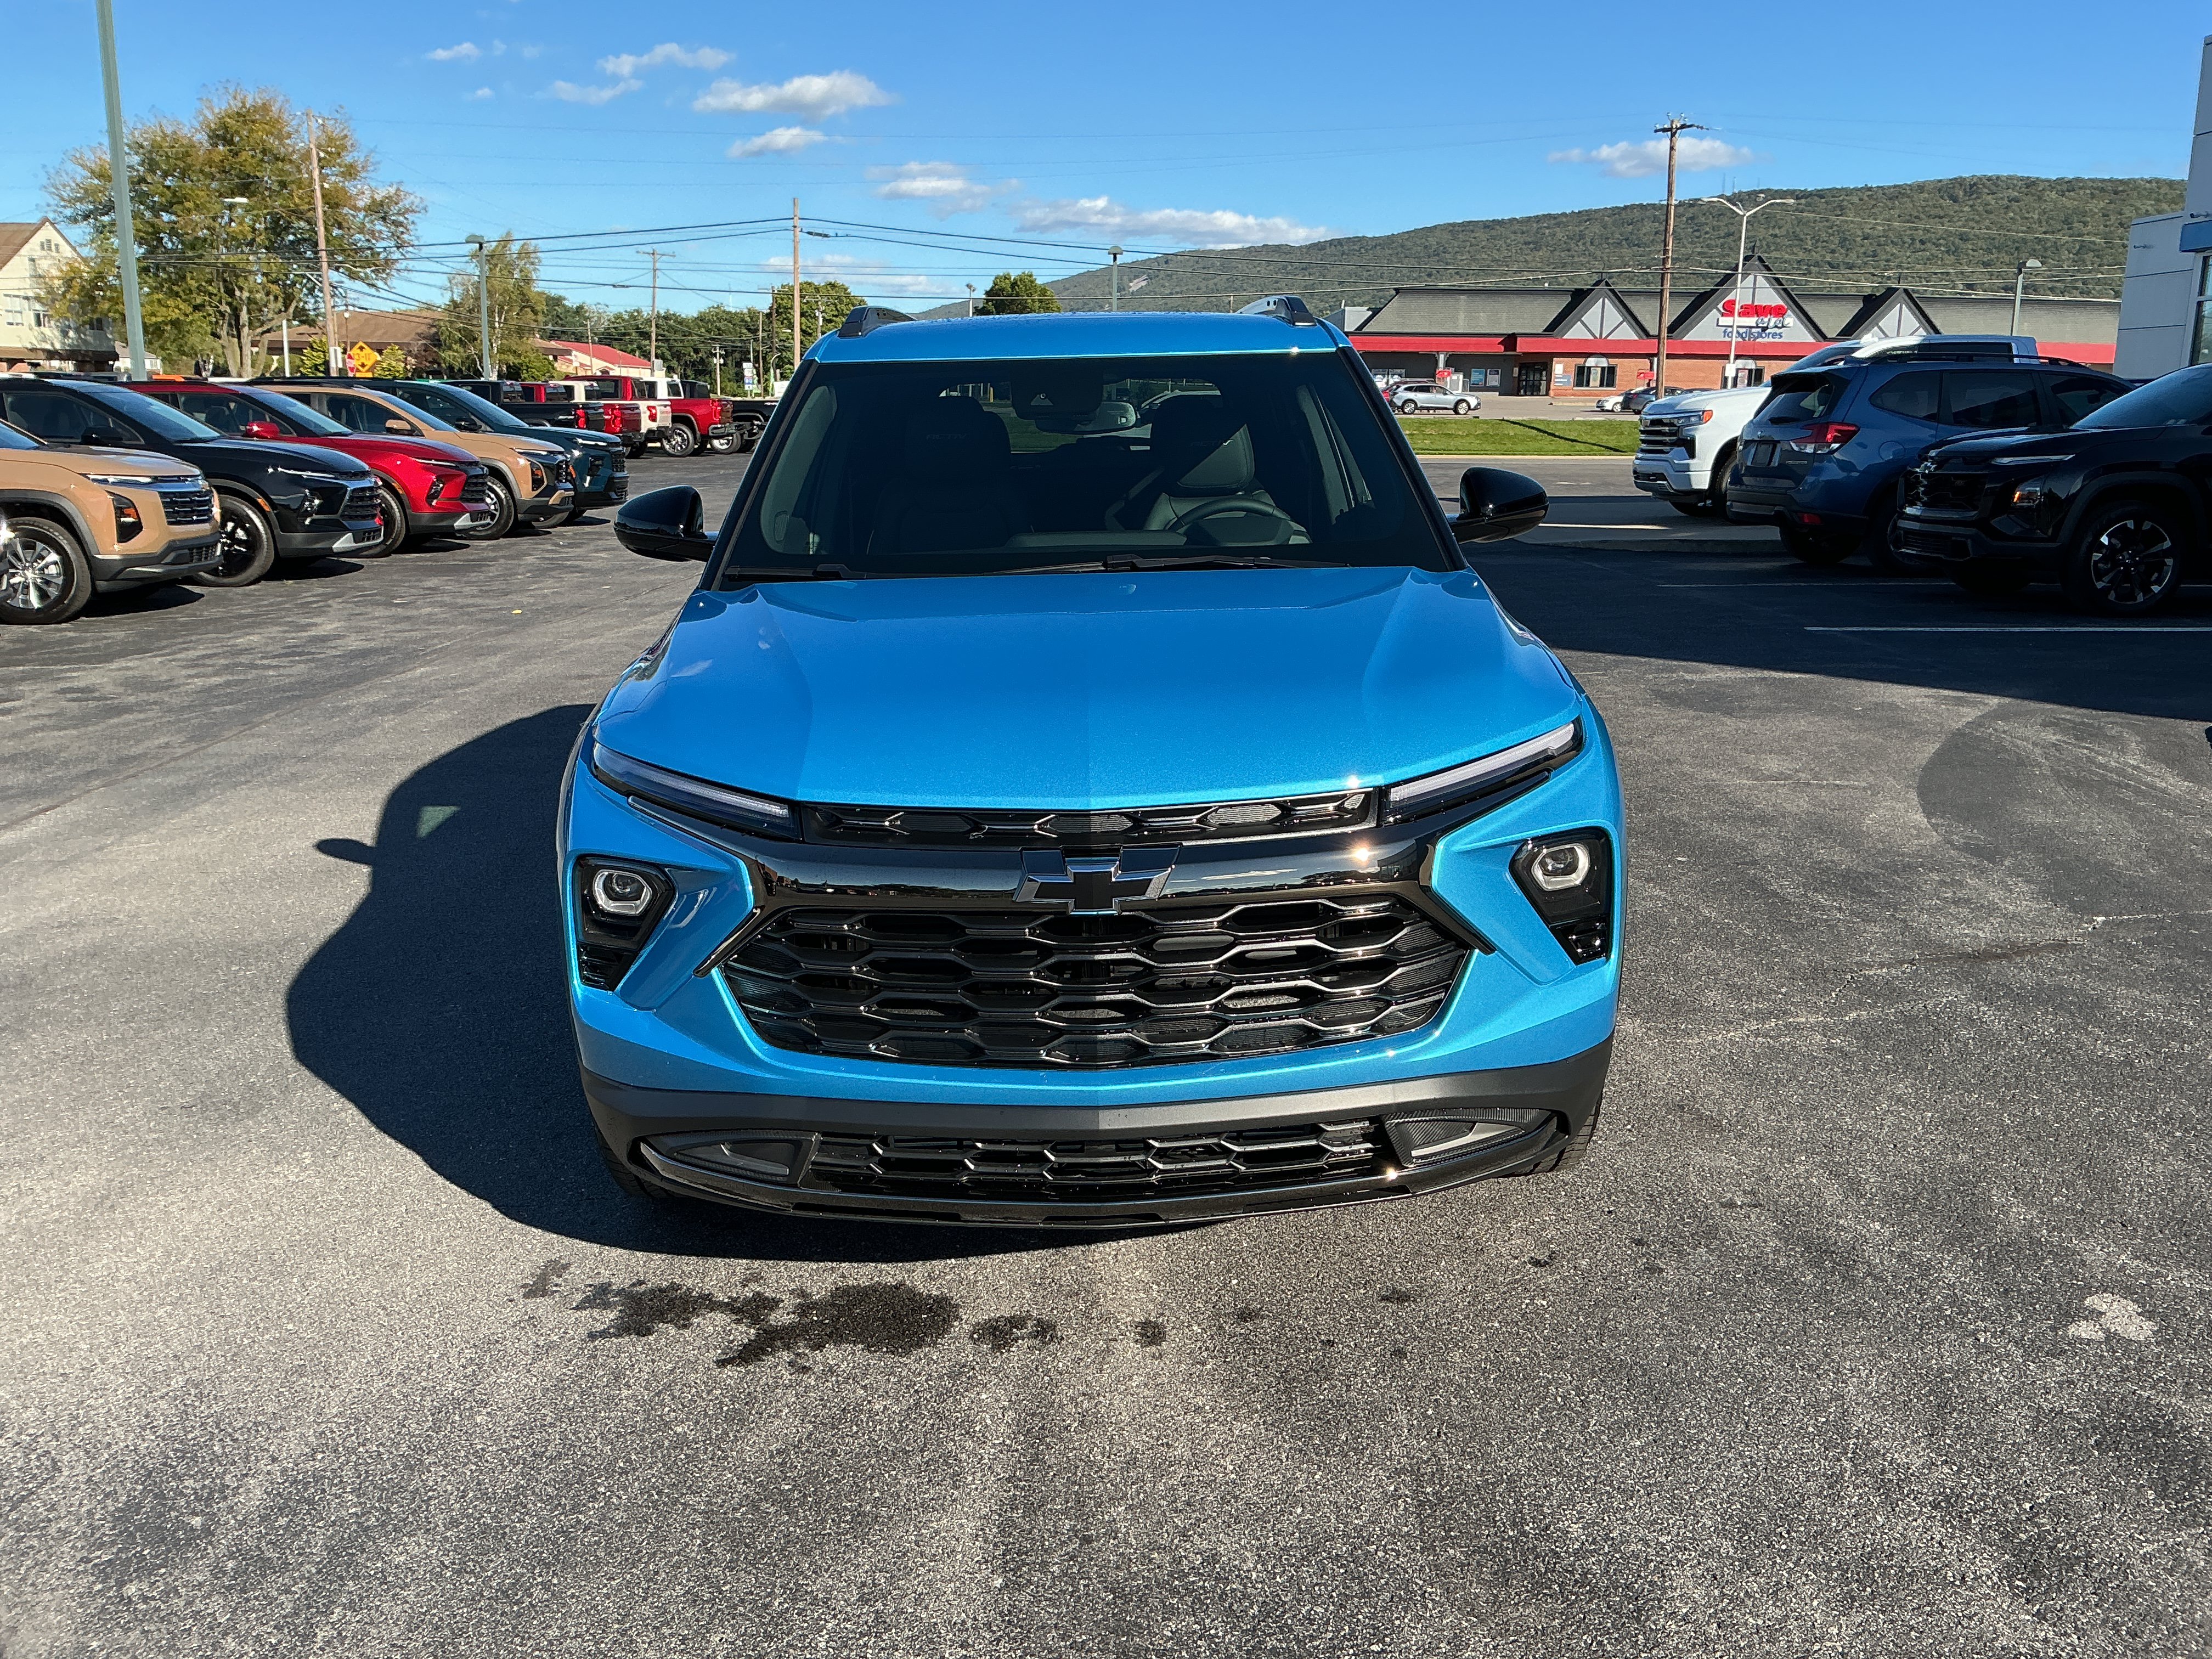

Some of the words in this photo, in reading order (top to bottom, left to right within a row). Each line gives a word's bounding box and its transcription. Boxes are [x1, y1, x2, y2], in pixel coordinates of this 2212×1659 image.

[1722, 298, 1788, 318] Save
[1723, 329, 1748, 339] food
[1751, 330, 1784, 339] stores
